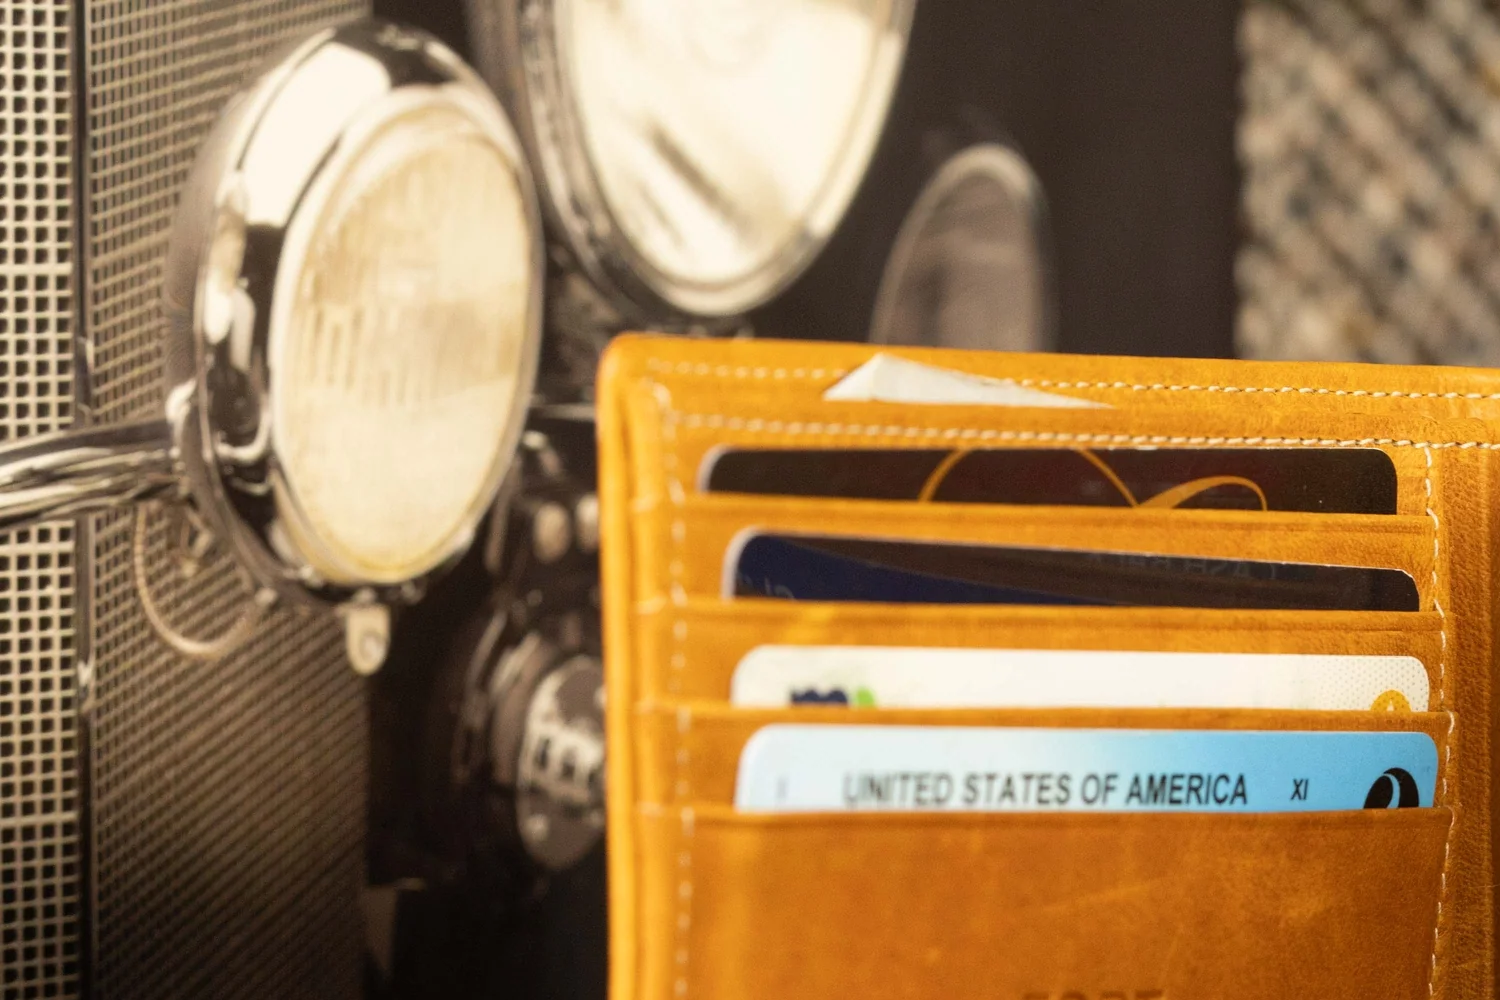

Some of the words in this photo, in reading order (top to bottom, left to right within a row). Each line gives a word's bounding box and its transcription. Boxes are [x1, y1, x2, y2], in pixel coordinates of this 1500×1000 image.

[842, 772, 954, 806] UNITED
[962, 772, 1072, 806] STATES
[1080, 772, 1119, 806] OF
[1125, 773, 1249, 806] AMERICA
